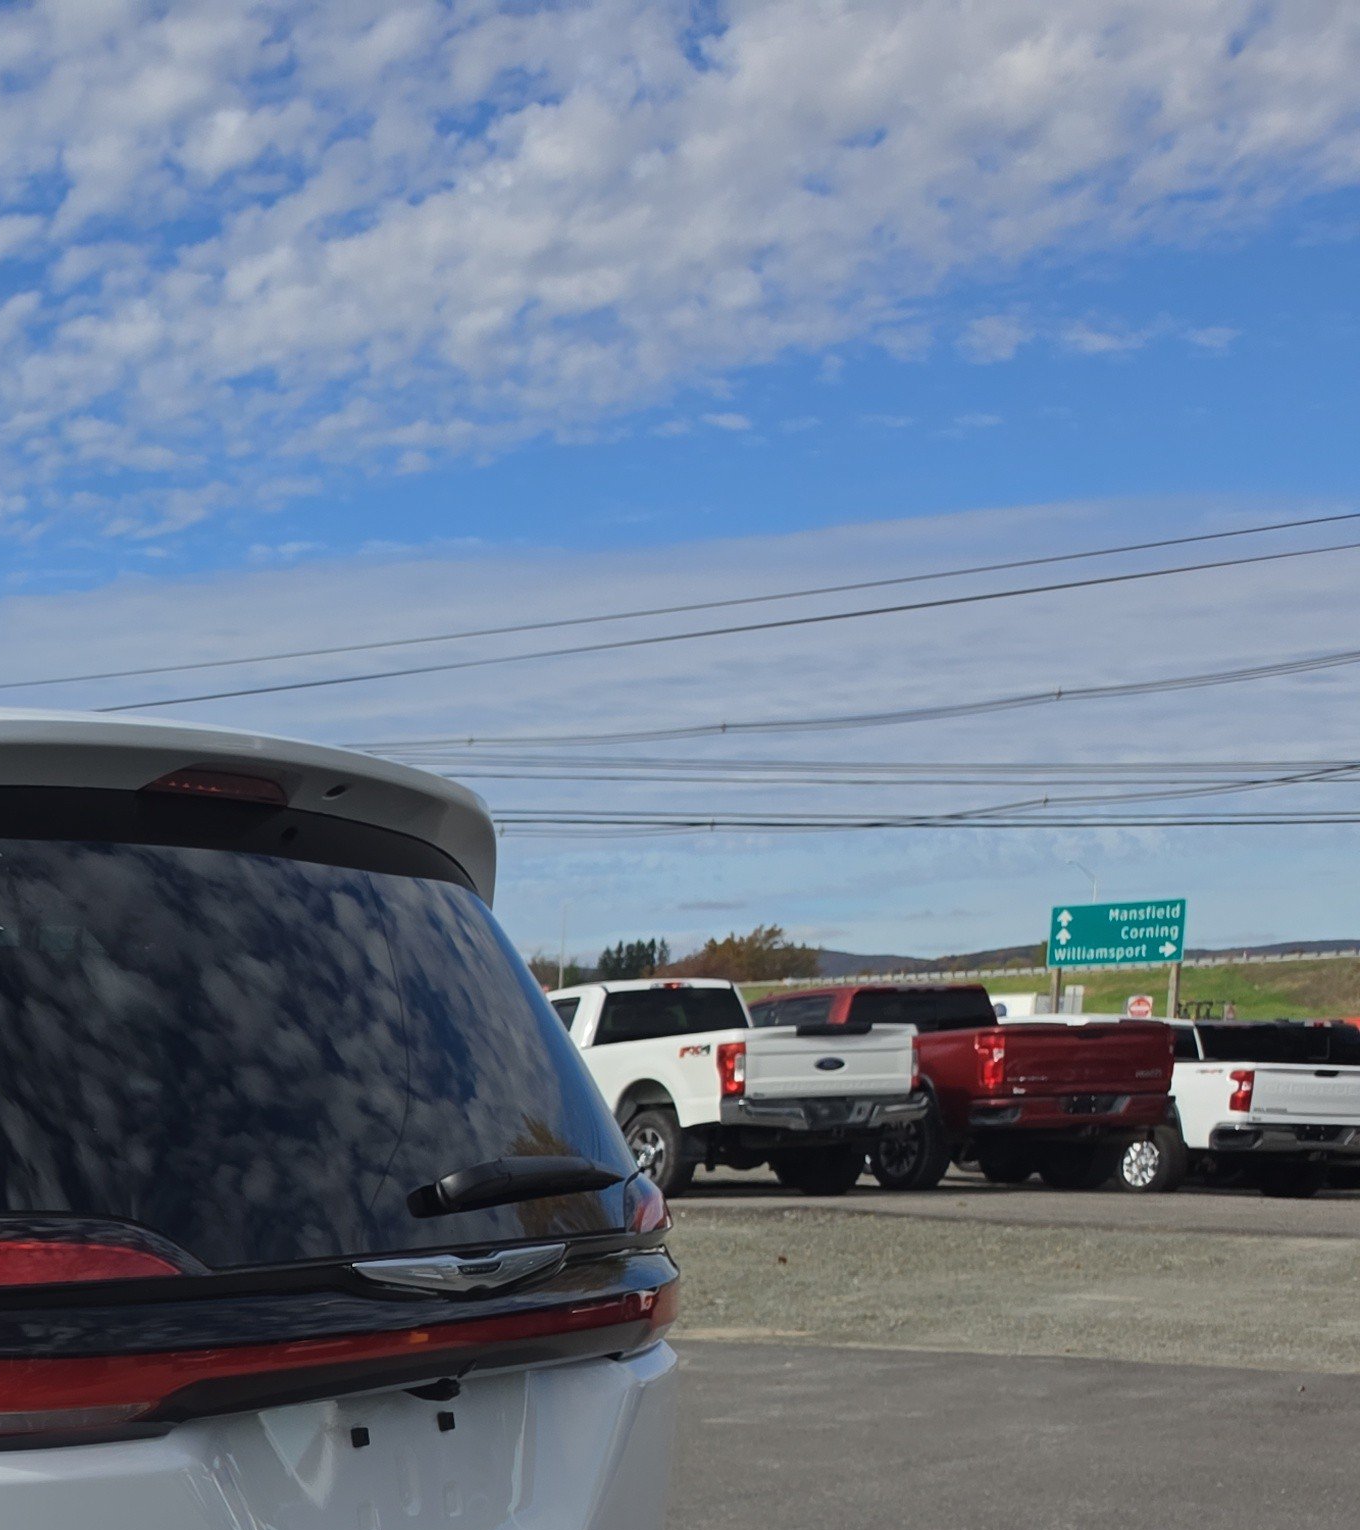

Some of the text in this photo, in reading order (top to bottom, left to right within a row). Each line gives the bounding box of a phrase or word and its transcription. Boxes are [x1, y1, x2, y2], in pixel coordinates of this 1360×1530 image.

[1109, 902, 1180, 922] Mansfield
[1121, 924, 1179, 940] Corning
[1054, 944, 1147, 962] Williamsport
